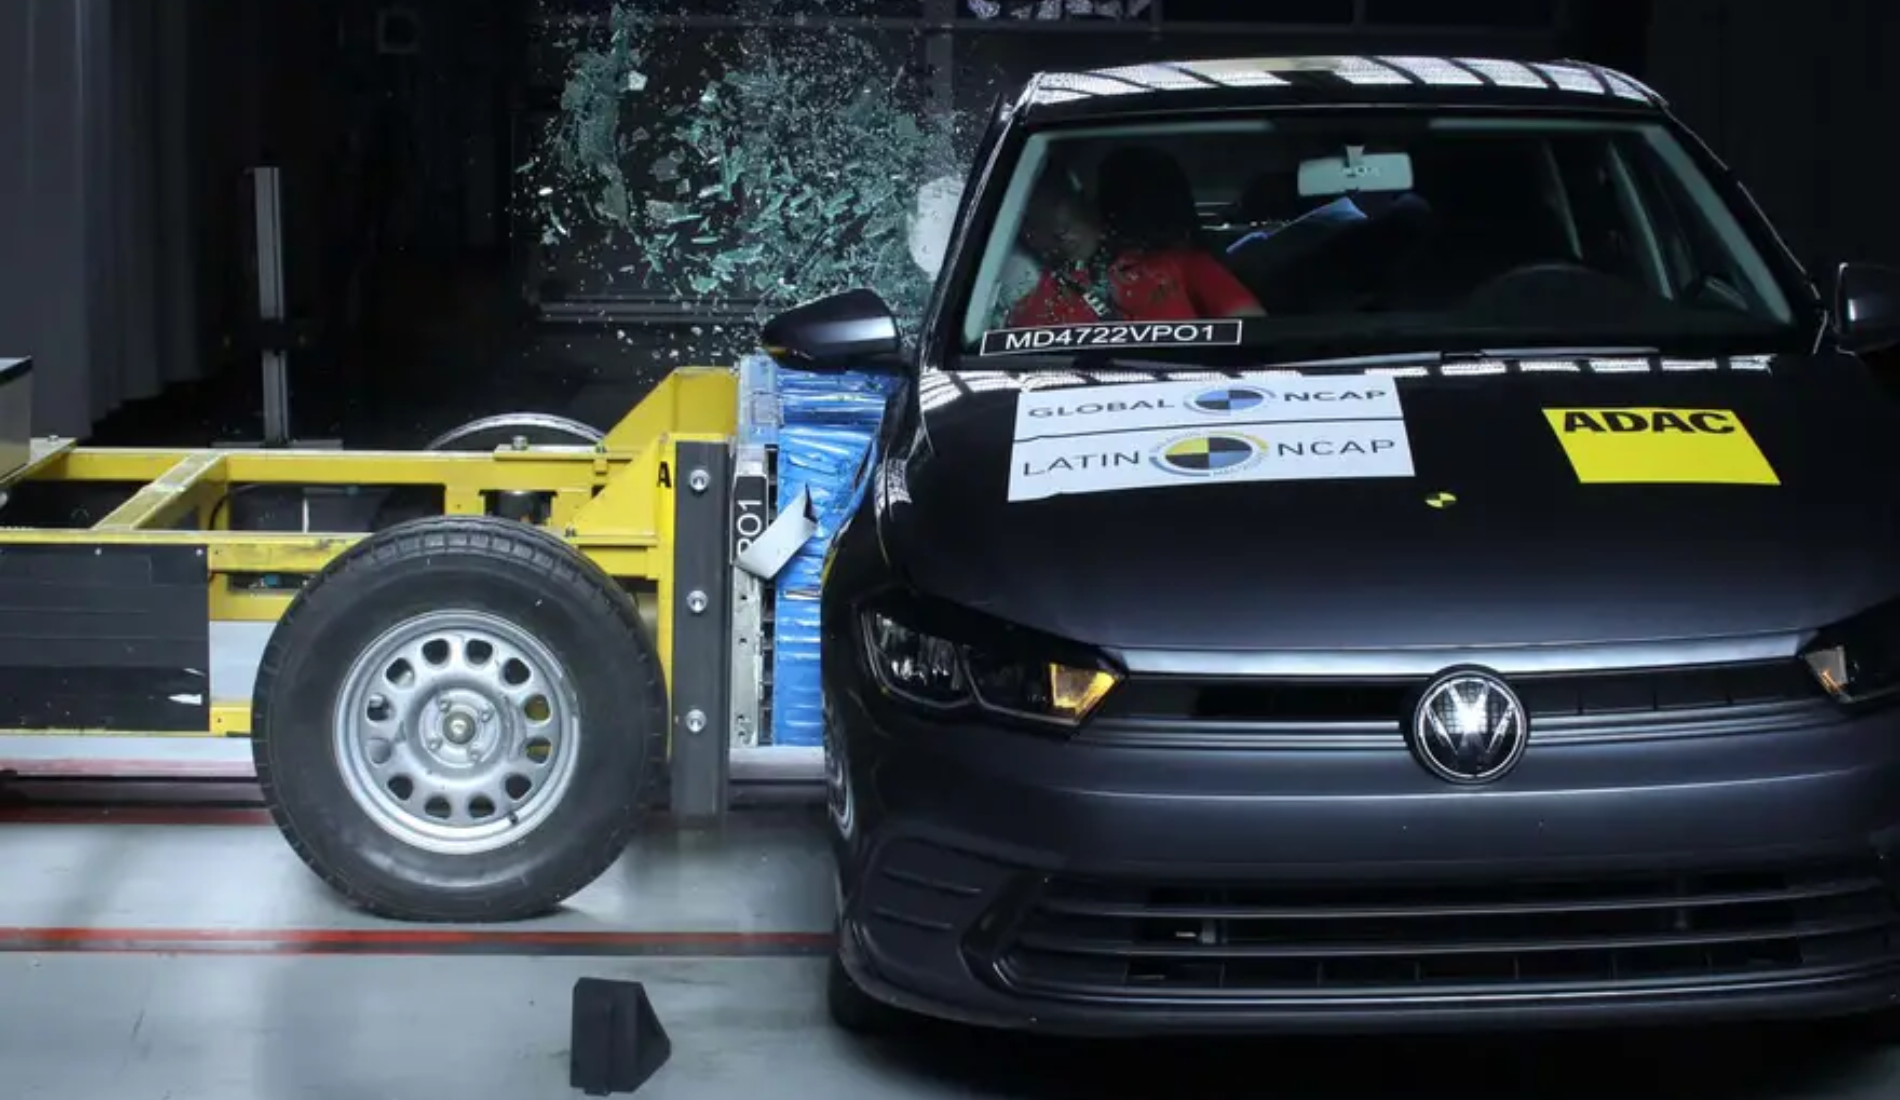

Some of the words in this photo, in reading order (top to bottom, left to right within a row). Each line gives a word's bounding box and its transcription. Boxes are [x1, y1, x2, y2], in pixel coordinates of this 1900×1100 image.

[1029, 399, 1175, 417] GLOBAL
[1284, 390, 1386, 402] NCAP
[1564, 411, 1735, 433] ADAC
[1023, 451, 1140, 475] LATIN
[1278, 440, 1396, 456] NCAP
[658, 461, 672, 488] A
